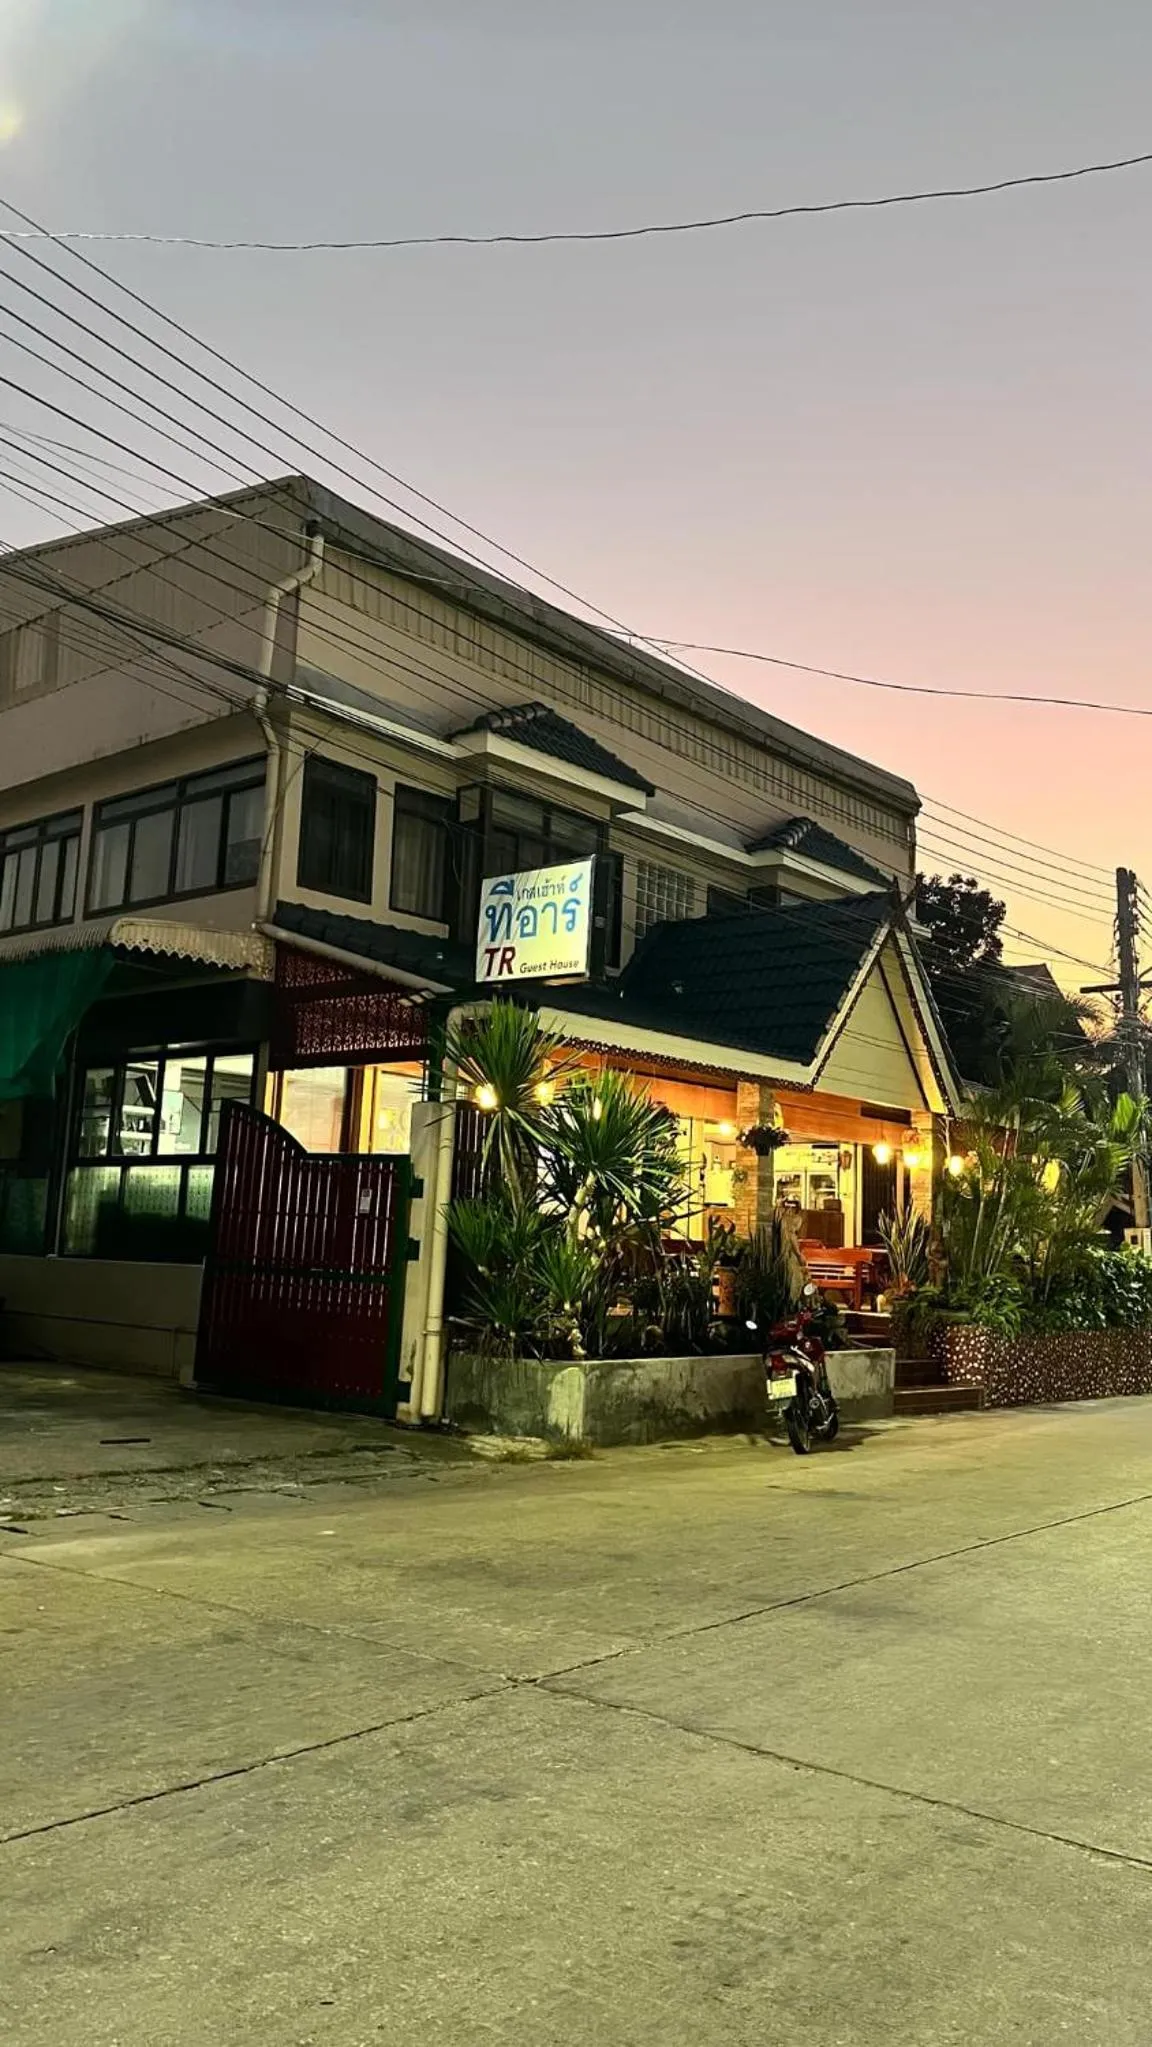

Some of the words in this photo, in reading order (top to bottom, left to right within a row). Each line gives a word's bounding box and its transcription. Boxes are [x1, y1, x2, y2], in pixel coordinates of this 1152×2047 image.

[485, 873, 583, 942] ทีอาร์
[484, 946, 516, 977] TR
[519, 961, 547, 974] Guest
[549, 959, 580, 971] House
